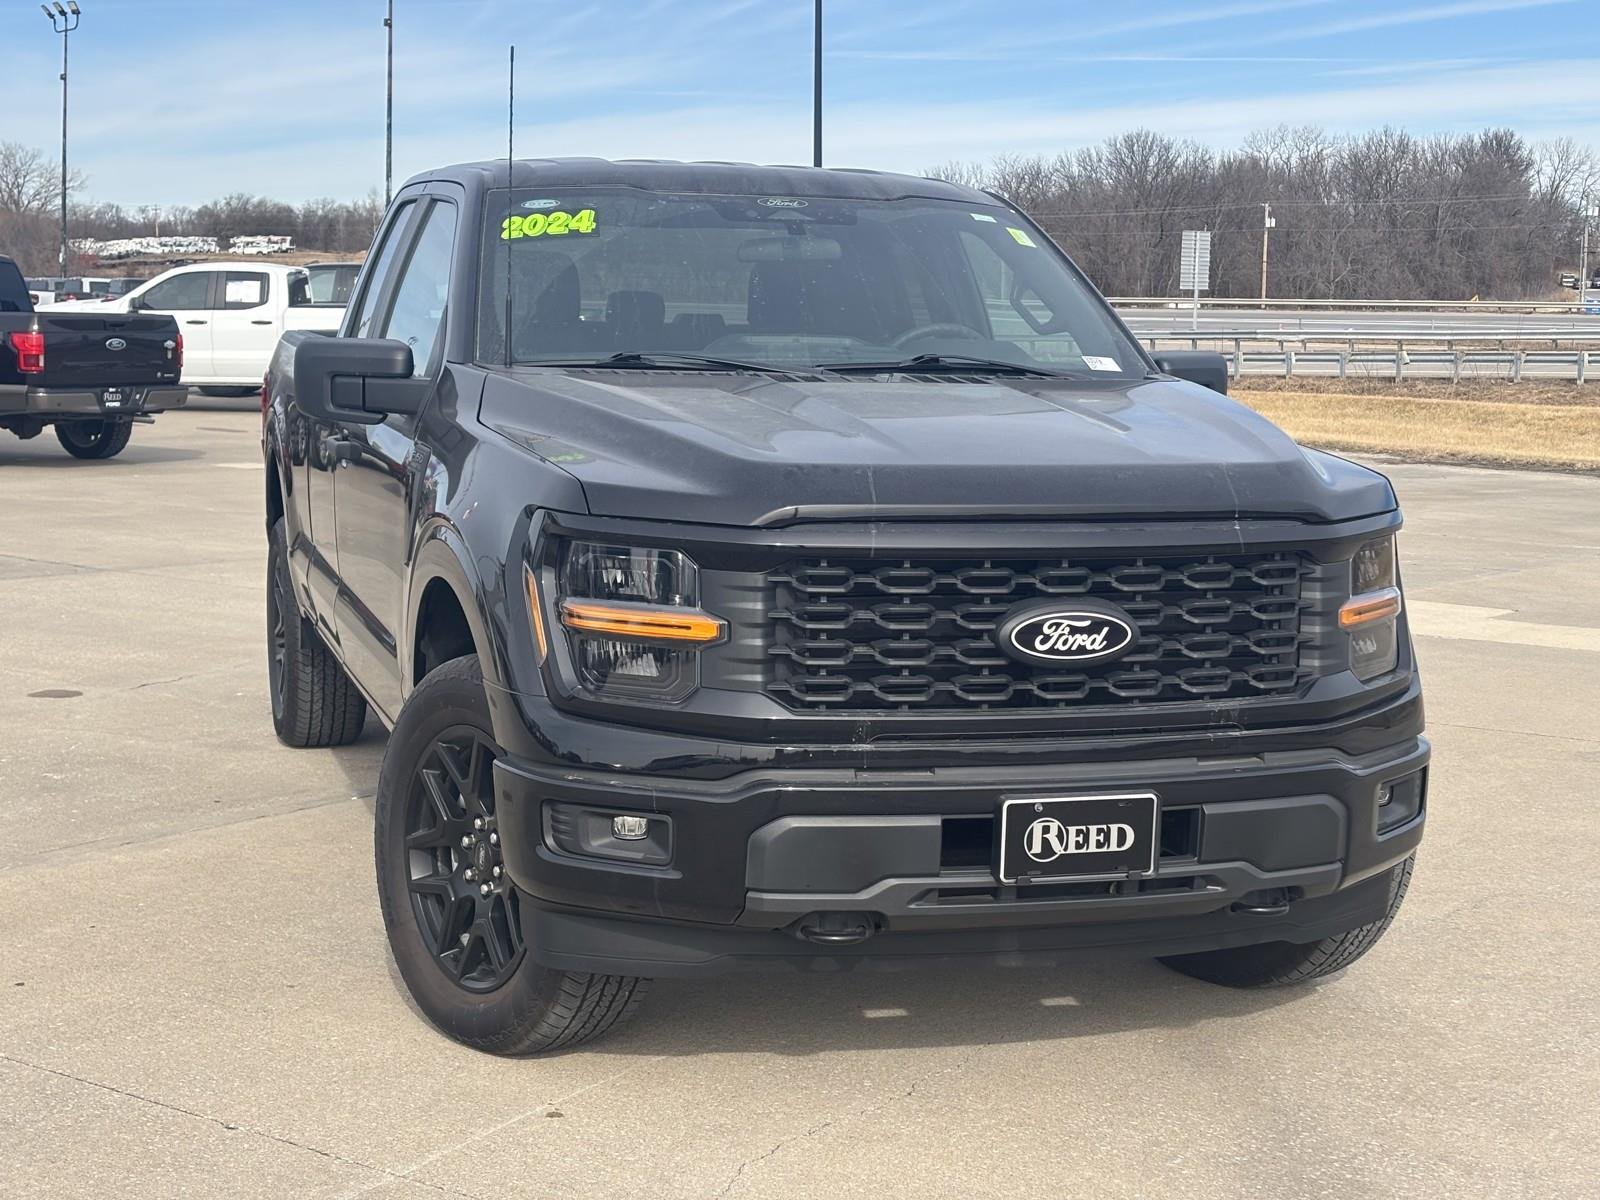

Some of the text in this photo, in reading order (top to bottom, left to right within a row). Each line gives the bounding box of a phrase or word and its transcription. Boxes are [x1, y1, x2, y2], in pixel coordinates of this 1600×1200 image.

[500, 209, 597, 240] 2024
[103, 392, 122, 401] REED
[1034, 619, 1110, 651] Ford
[1030, 822, 1135, 854] REED
